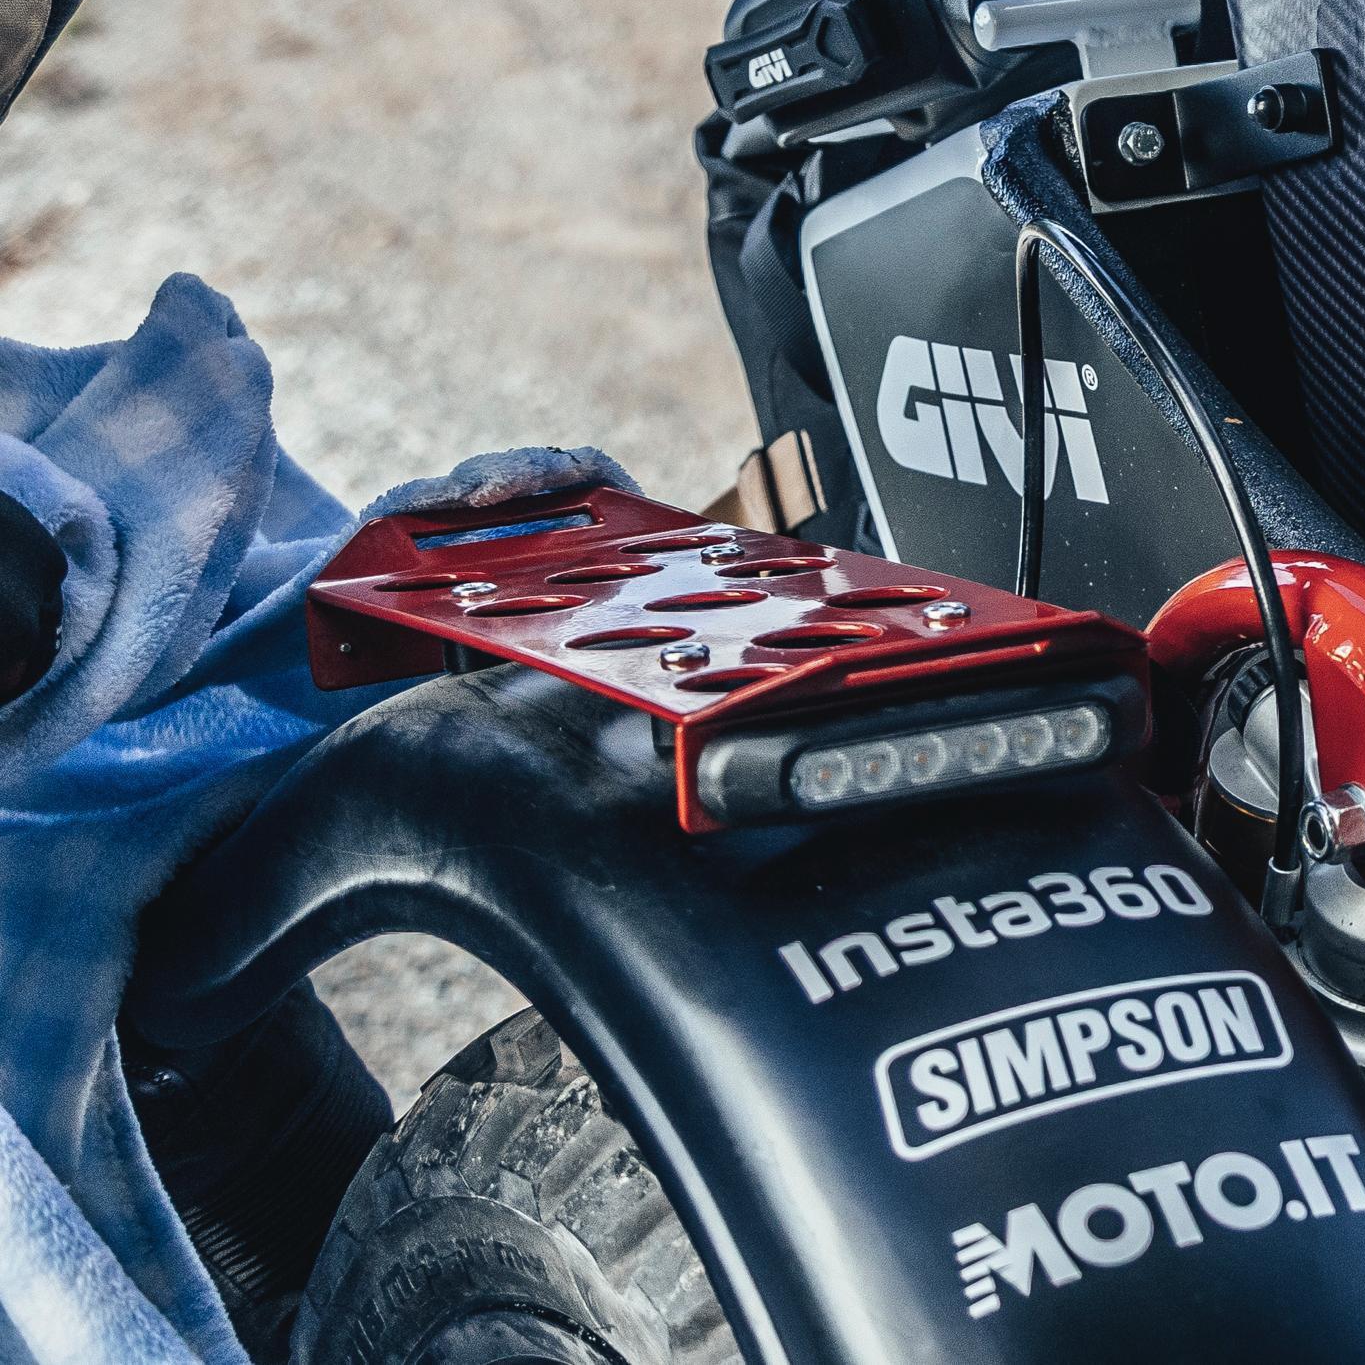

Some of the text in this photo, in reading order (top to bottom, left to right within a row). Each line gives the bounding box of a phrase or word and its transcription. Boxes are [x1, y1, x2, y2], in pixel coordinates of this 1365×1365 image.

[748, 47, 793, 89] GIVI
[778, 864, 1214, 1004] Insta360
[909, 986, 1265, 1131] SIMPSON
